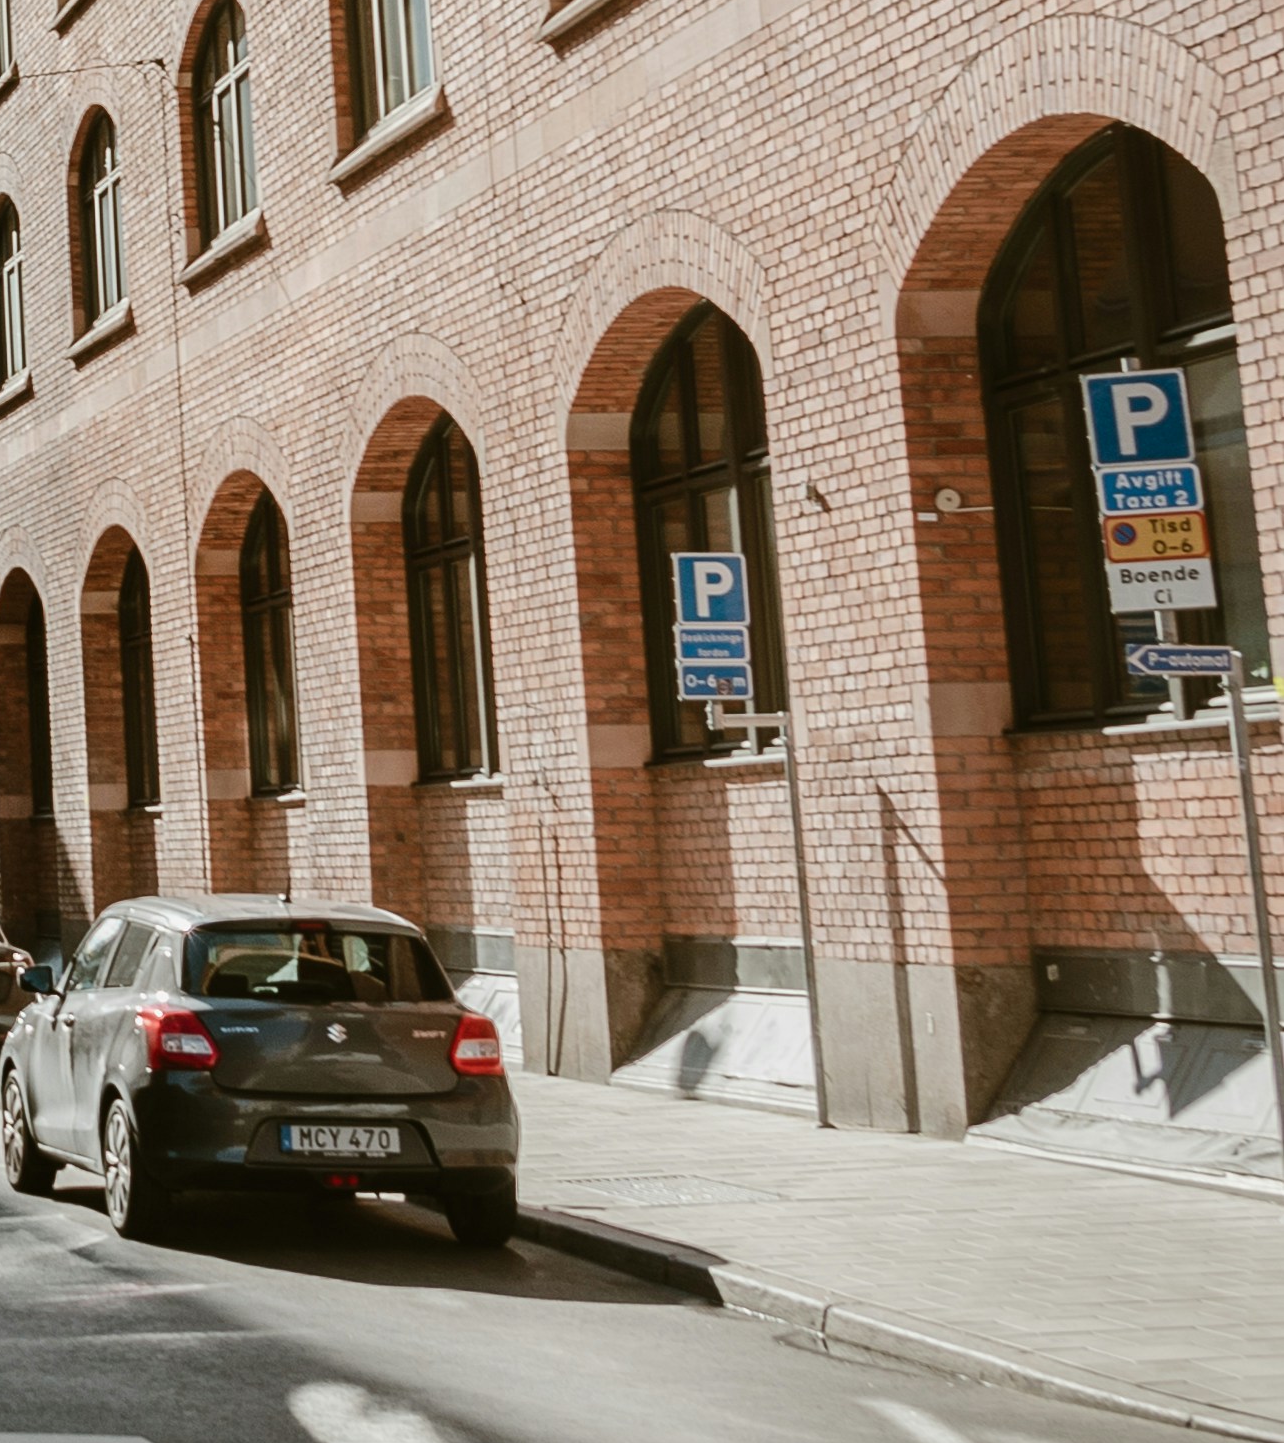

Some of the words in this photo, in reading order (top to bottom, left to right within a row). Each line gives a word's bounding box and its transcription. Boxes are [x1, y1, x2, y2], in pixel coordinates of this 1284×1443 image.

[1111, 382, 1169, 456] P
[1115, 470, 1183, 491] Avgift
[1113, 493, 1168, 509] Taxa
[1174, 489, 1190, 506] 2
[1148, 518, 1192, 534] Tisd
[1120, 565, 1200, 584] Boende
[693, 561, 734, 618] P
[1154, 589, 1173, 604] Ci
[1147, 651, 1229, 667] P-automat
[299, 1128, 341, 1148] MCY
[349, 1129, 390, 1149] 470
